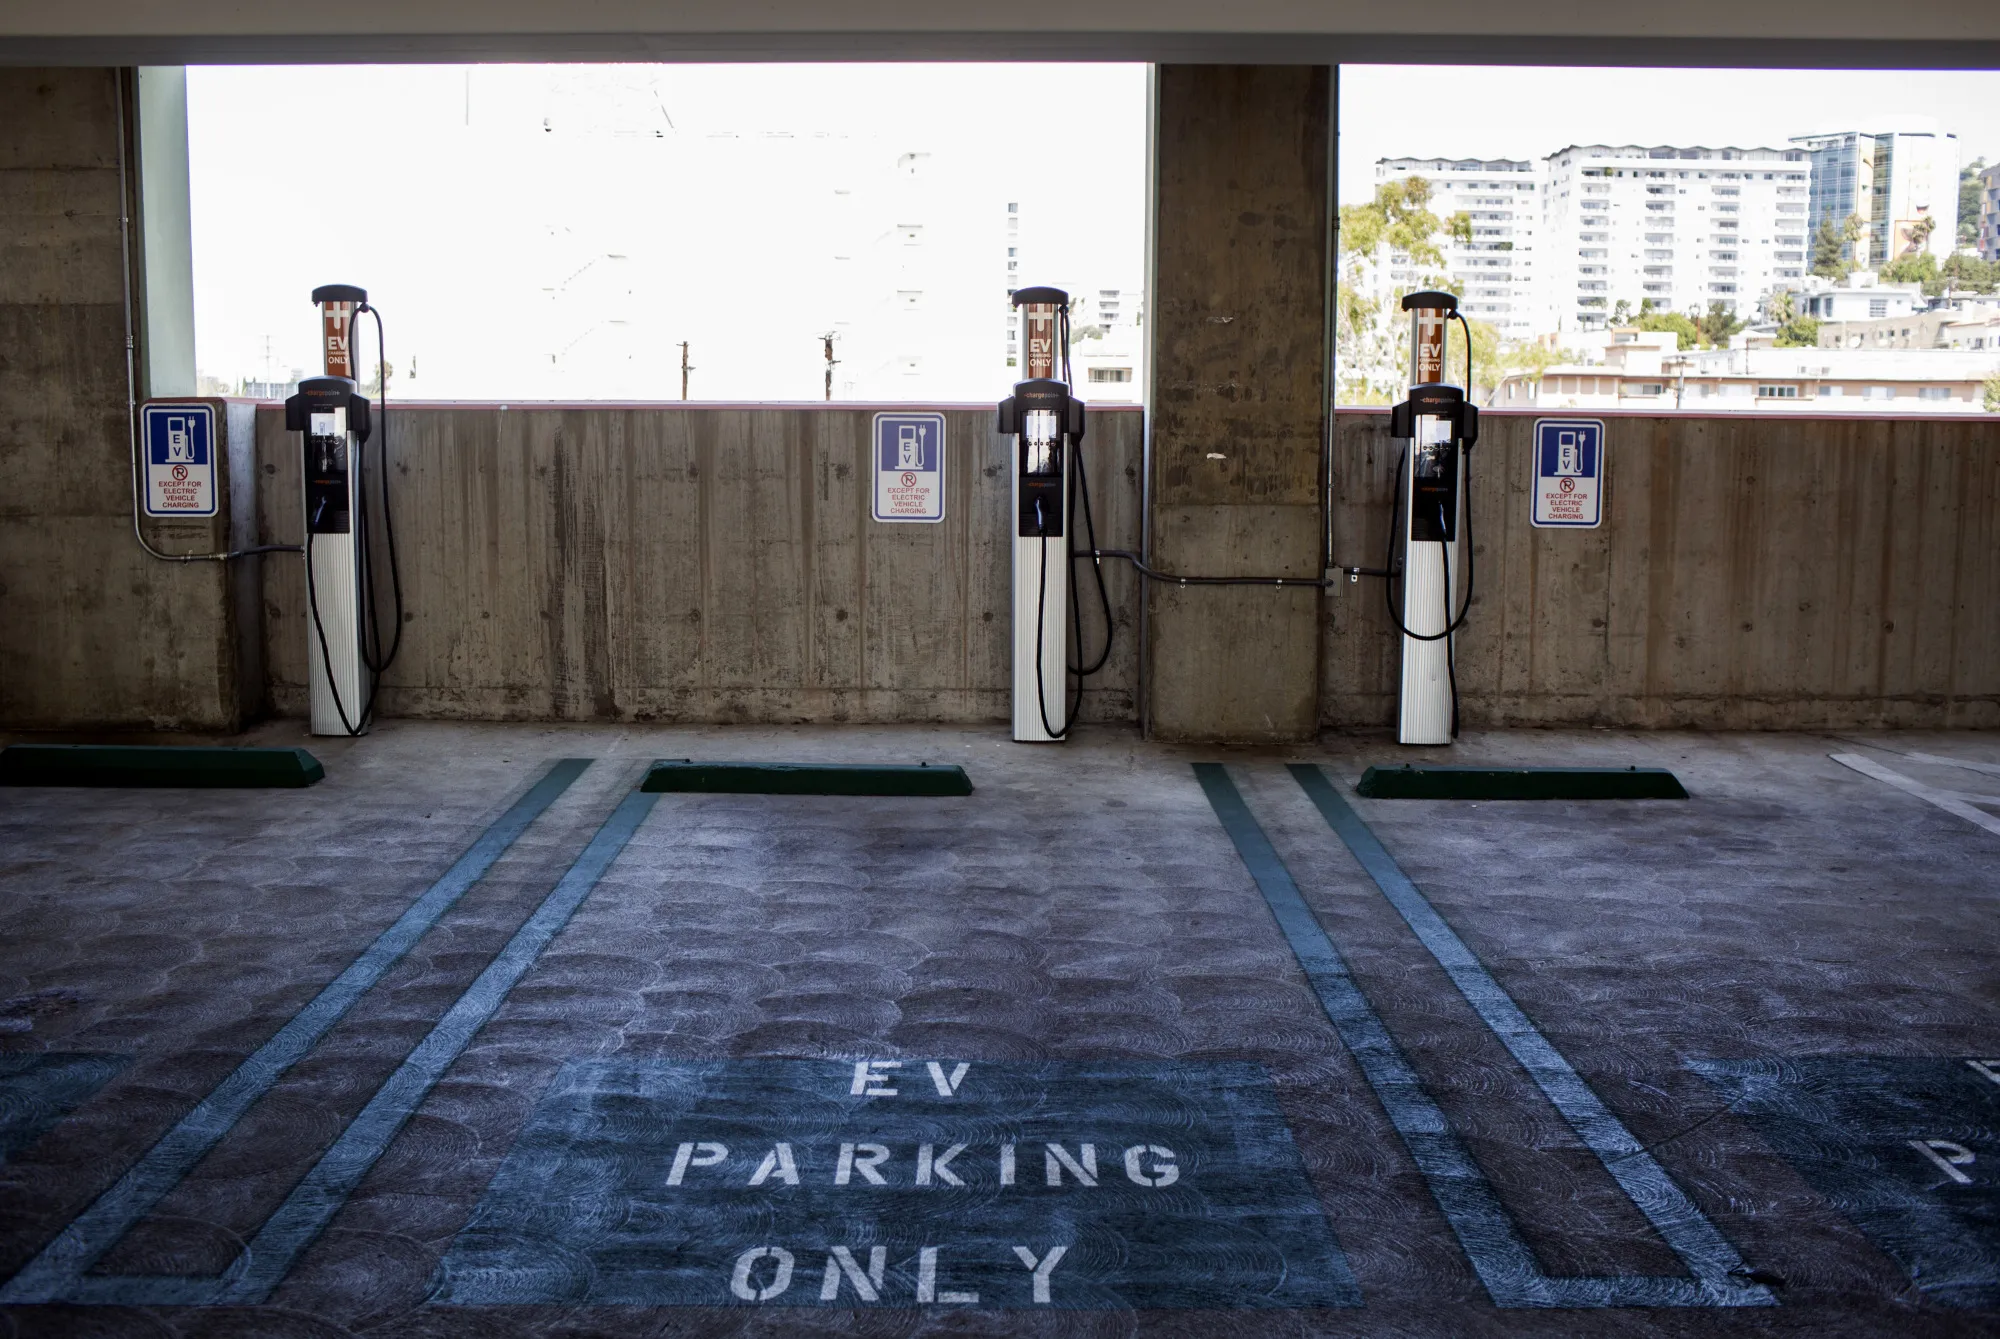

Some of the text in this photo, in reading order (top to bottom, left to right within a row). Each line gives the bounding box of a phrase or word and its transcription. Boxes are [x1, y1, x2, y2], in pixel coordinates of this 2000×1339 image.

[328, 336, 349, 350] EV
[1030, 338, 1052, 353] EV
[1420, 343, 1441, 358] EV
[328, 356, 350, 364] ONLY
[1030, 359, 1052, 367] ONLY
[1419, 363, 1441, 372] ONLY
[850, 1060, 971, 1097] EV
[666, 1142, 1181, 1186] PARKING
[730, 1244, 1068, 1304] ONLY
